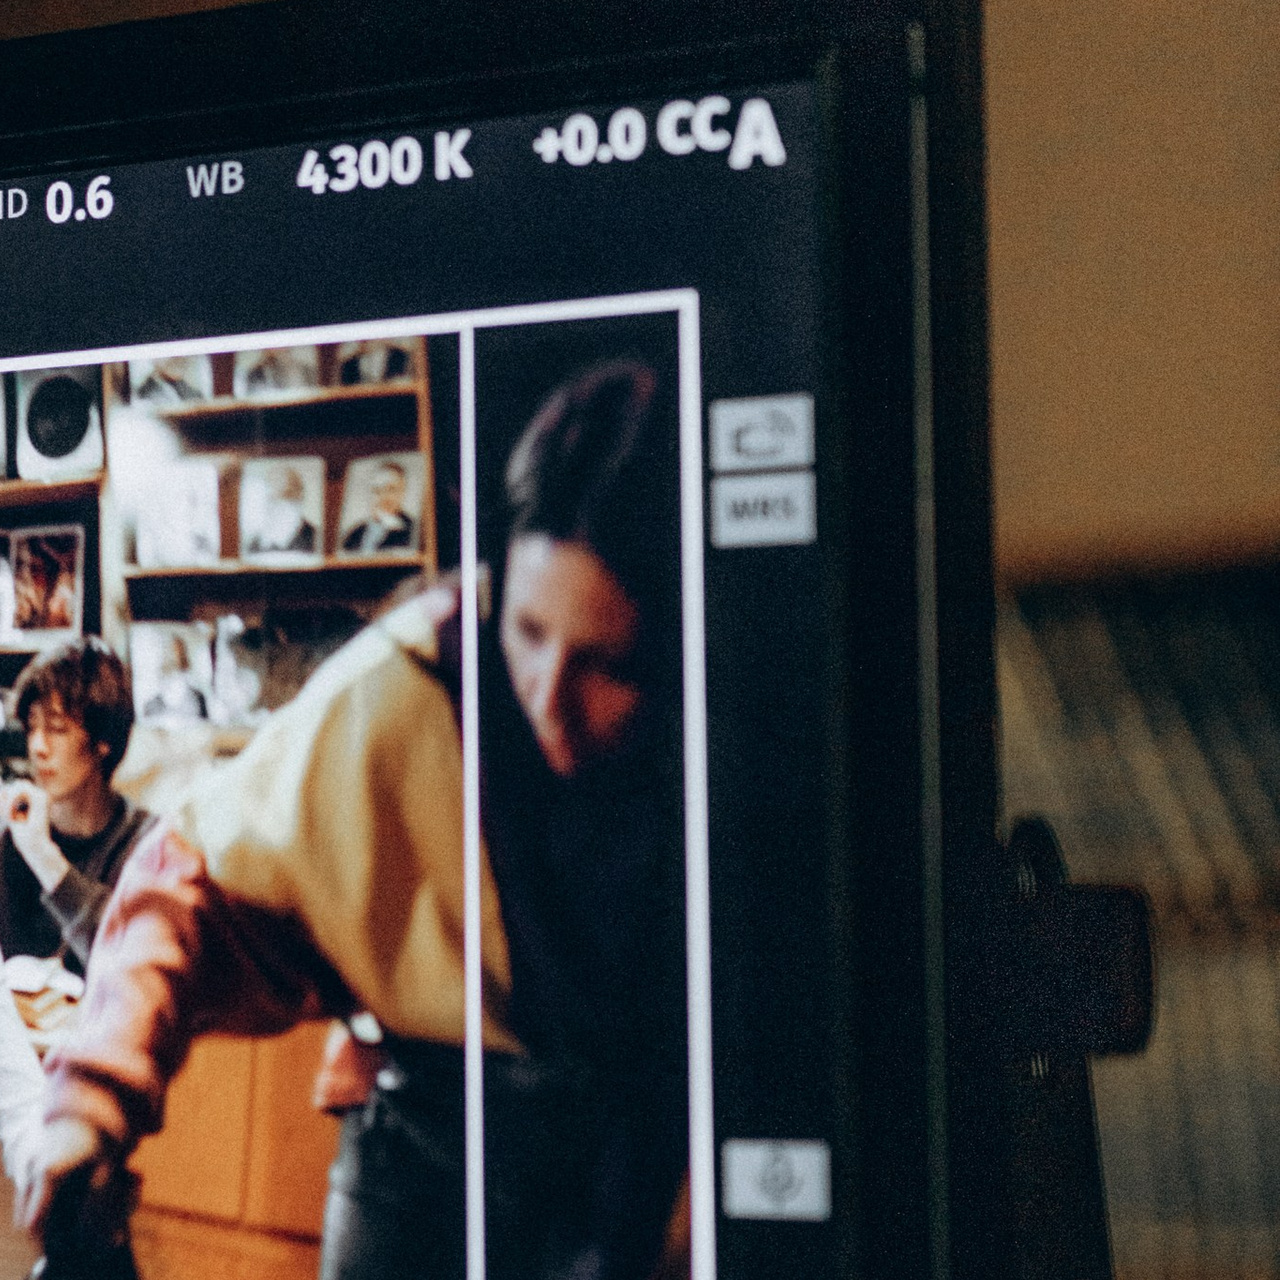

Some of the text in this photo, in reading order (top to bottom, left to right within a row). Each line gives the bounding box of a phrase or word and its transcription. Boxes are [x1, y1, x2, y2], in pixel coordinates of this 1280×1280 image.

[186, 129, 473, 198] WB 4300 K
[532, 95, 731, 166] +0.0 CC
[45, 175, 114, 224] 0.6
